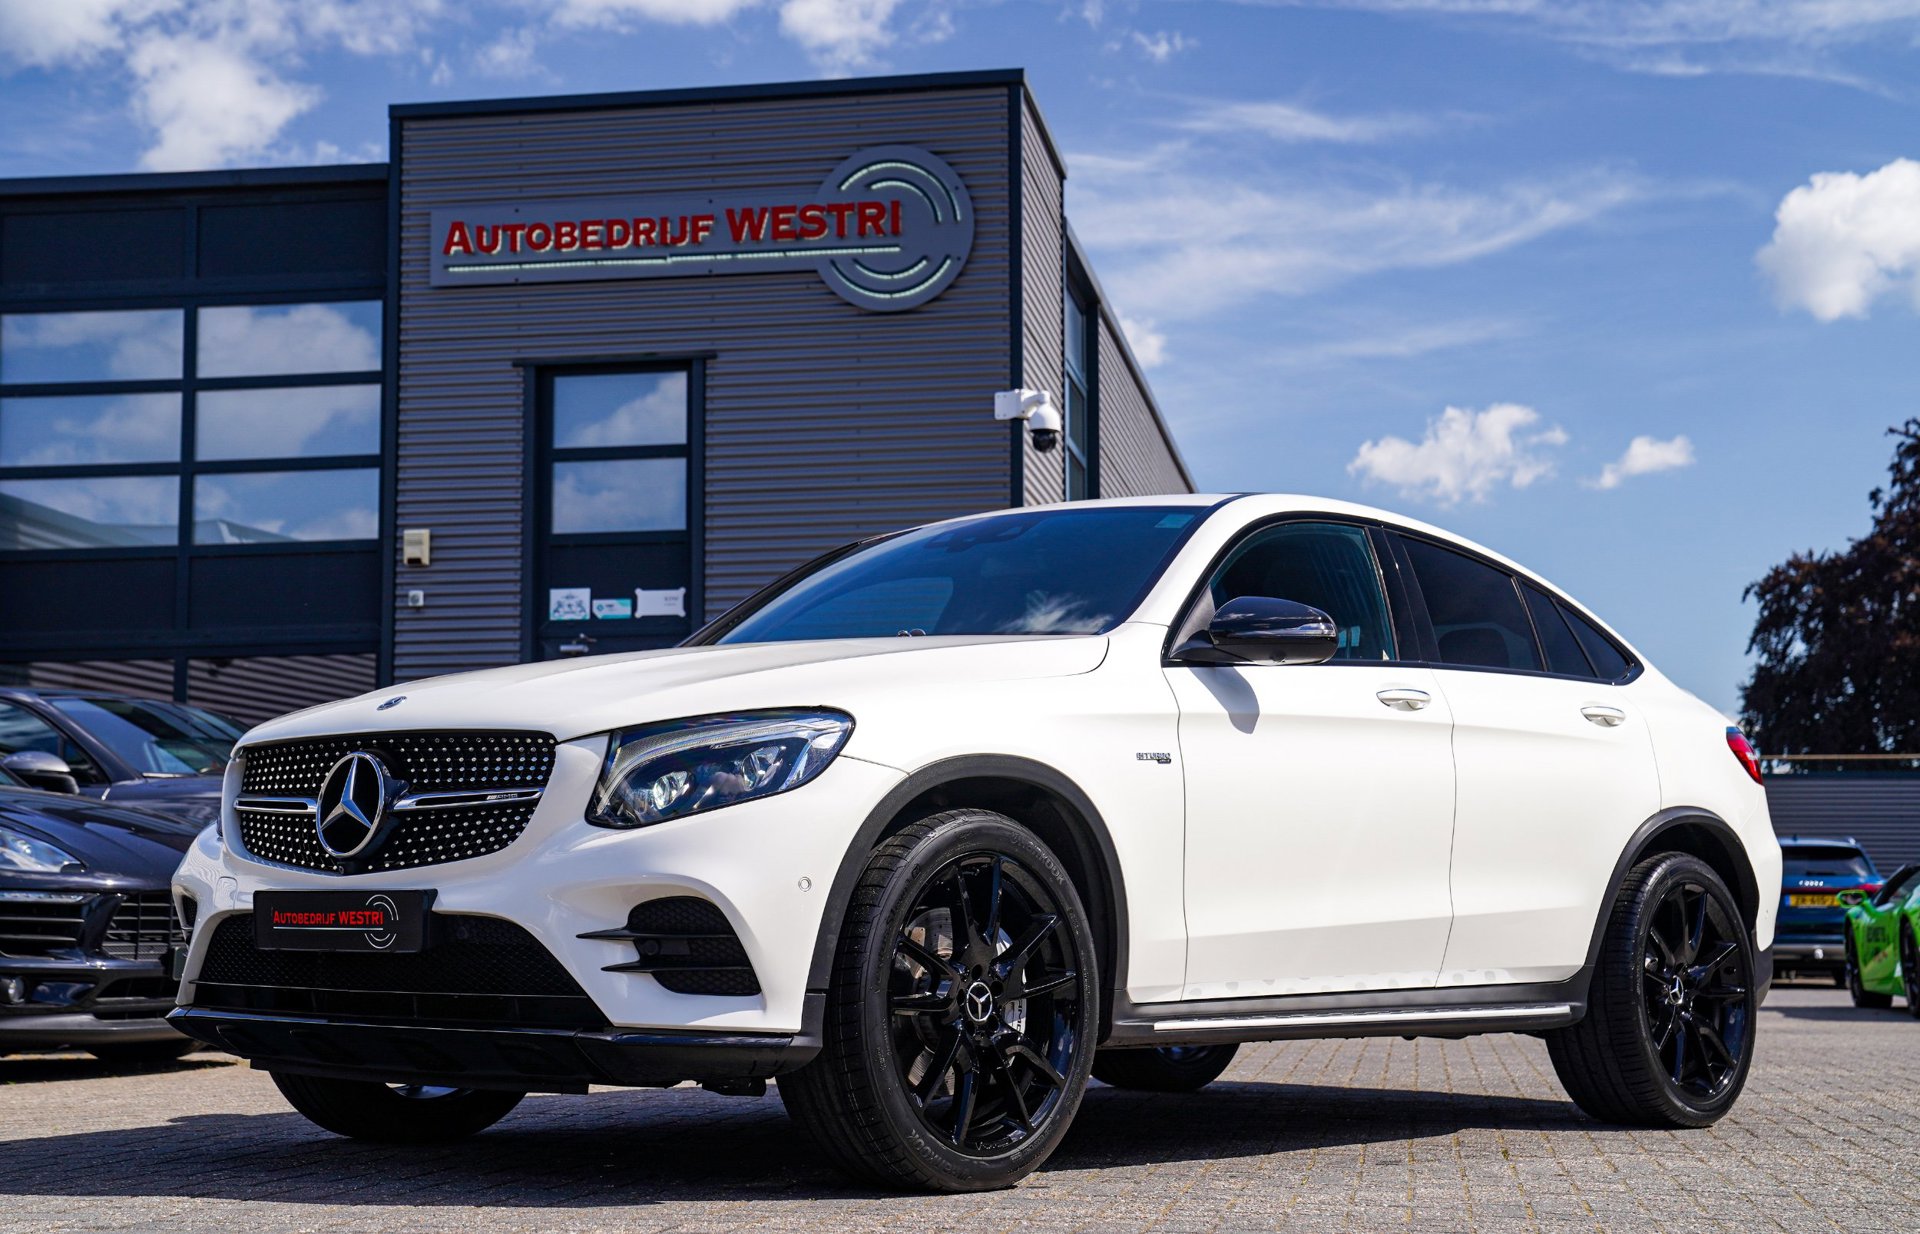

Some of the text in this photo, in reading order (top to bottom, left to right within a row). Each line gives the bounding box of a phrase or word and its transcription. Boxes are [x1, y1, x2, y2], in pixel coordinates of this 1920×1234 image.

[443, 199, 903, 256] AUTOBEDRIJF WESTRI
[273, 911, 384, 925] AUTOBEDRIJF WESTRI
